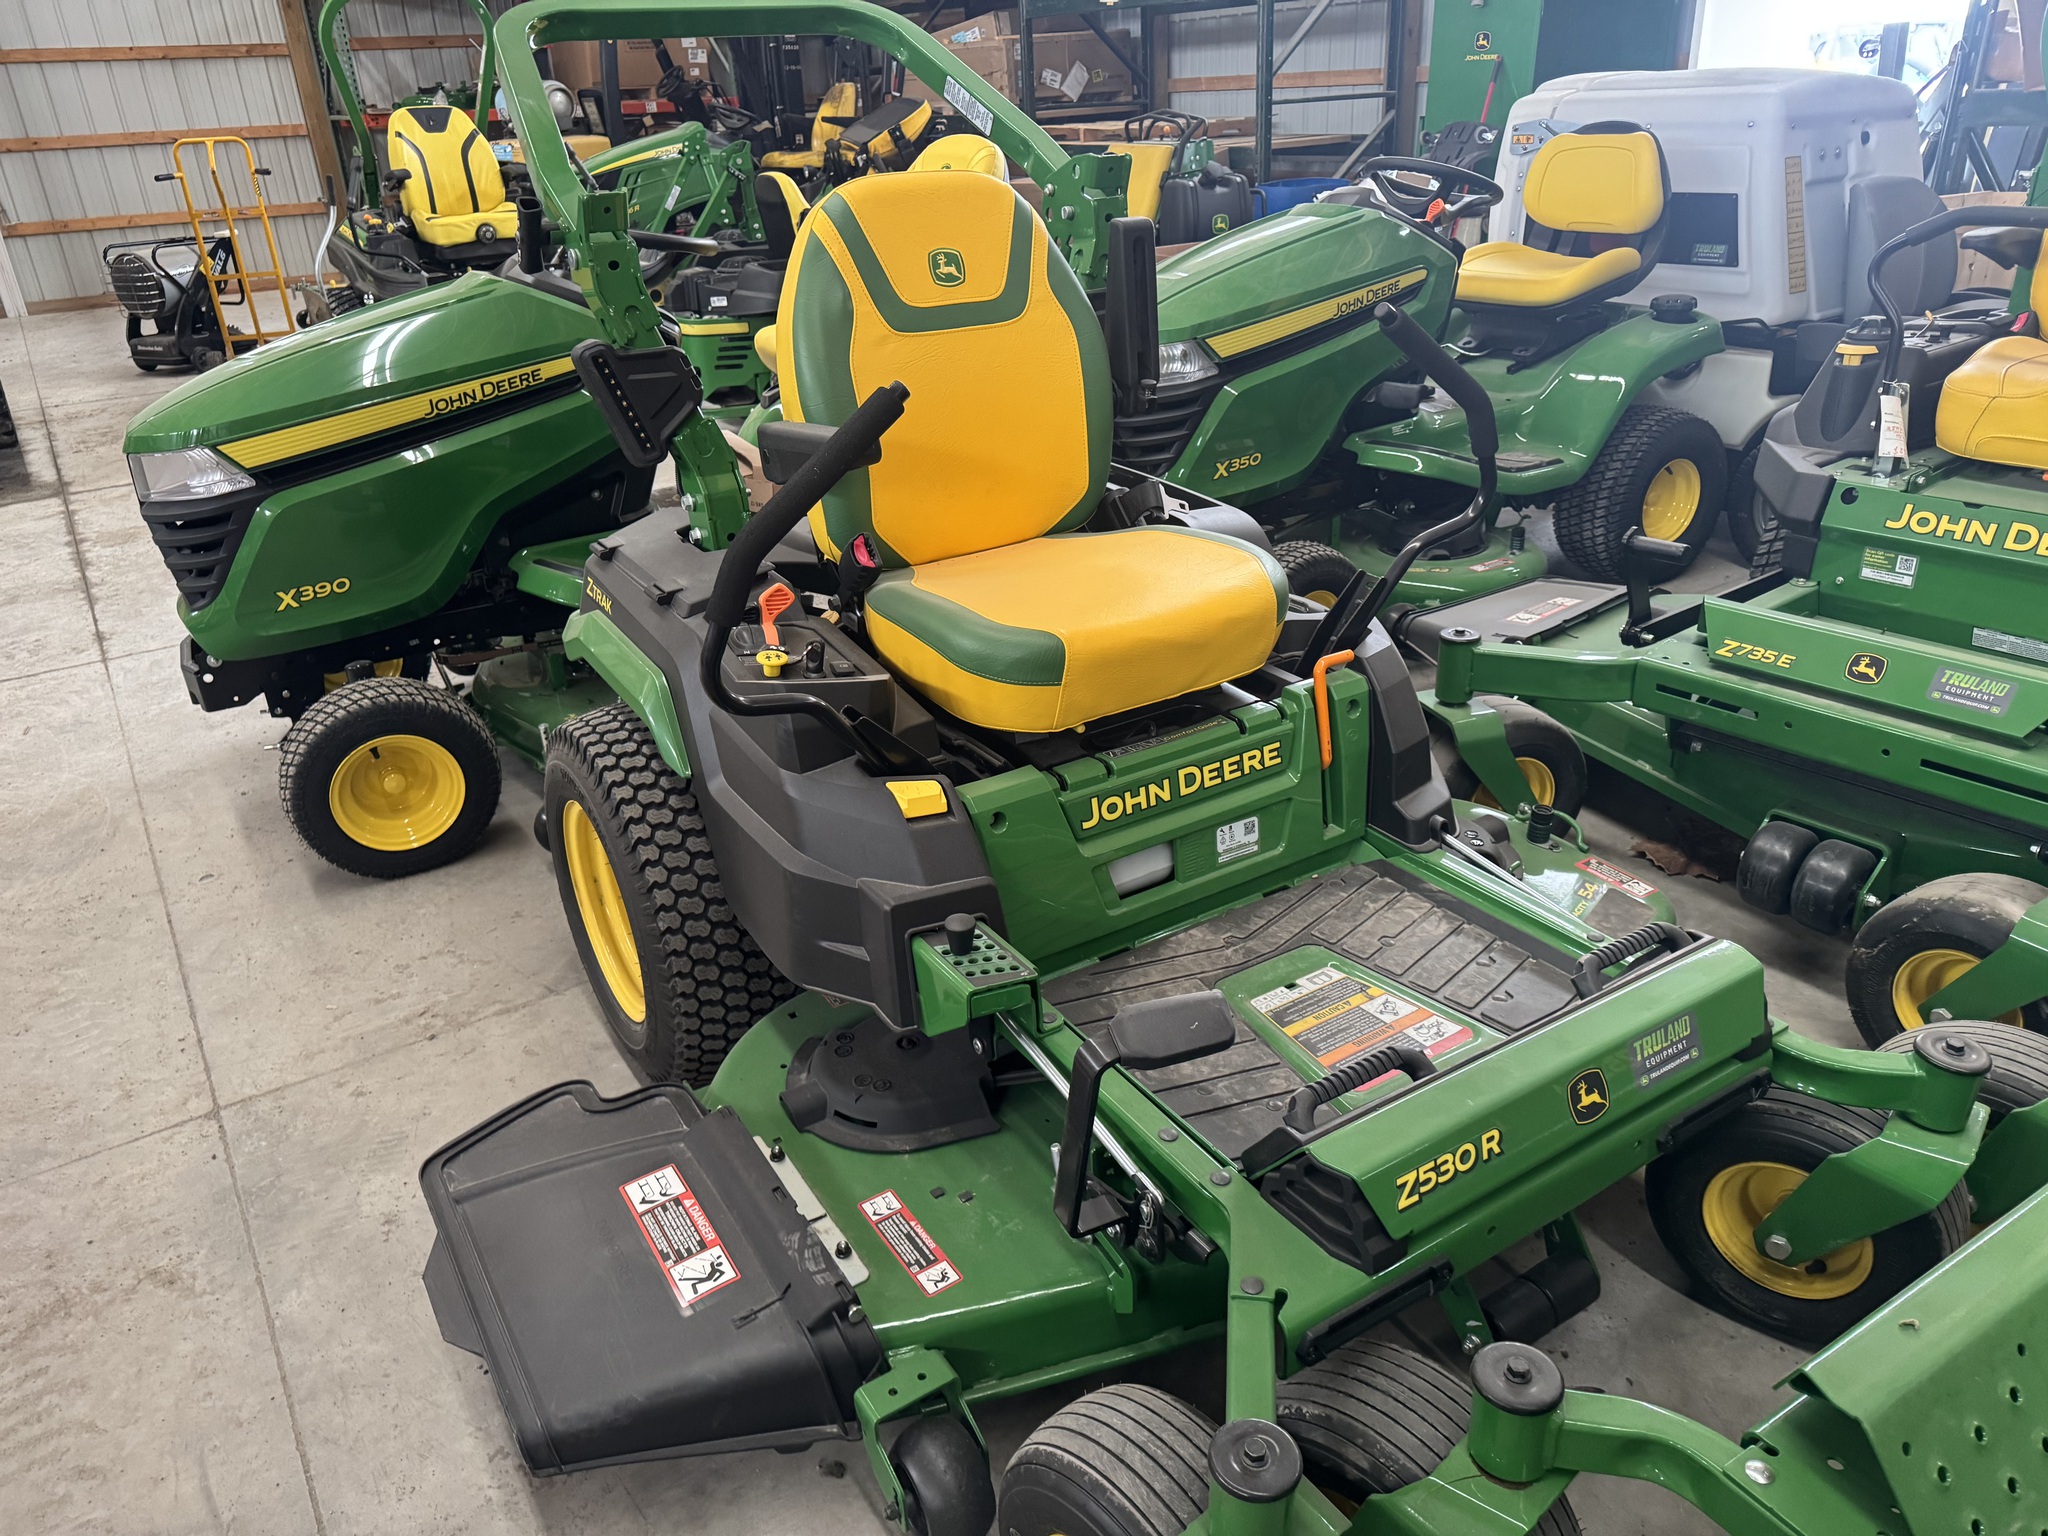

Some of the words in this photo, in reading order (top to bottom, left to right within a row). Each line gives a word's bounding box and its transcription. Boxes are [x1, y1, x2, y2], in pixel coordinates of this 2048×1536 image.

[1695, 244, 1725, 253] TRULAND
[1333, 295, 1364, 318] JOHN
[1366, 280, 1401, 303] DEERE
[425, 388, 477, 417] JOHN
[480, 368, 544, 398] DEERE
[1213, 453, 1262, 480] X350
[1884, 503, 1999, 546] JOHN
[275, 577, 351, 612] X390
[587, 577, 612, 615] ZTRAK
[1941, 669, 2011, 697] TRULAND
[1945, 685, 1994, 702] EQUIPMENT
[1081, 778, 1171, 830] JOHN
[1177, 741, 1282, 797] DEERE
[1578, 882, 1599, 900] 54
[1312, 1004, 1346, 1021] CAUTION
[1352, 1027, 1391, 1047] WARNING
[1633, 1015, 1690, 1061] TRULAND
[1645, 1040, 1687, 1068] EQUIPMENT
[1396, 1142, 1477, 1211] Z530
[1481, 1128, 1503, 1161] R
[689, 1204, 716, 1242] DANGER
[914, 1224, 937, 1249] DANGER
